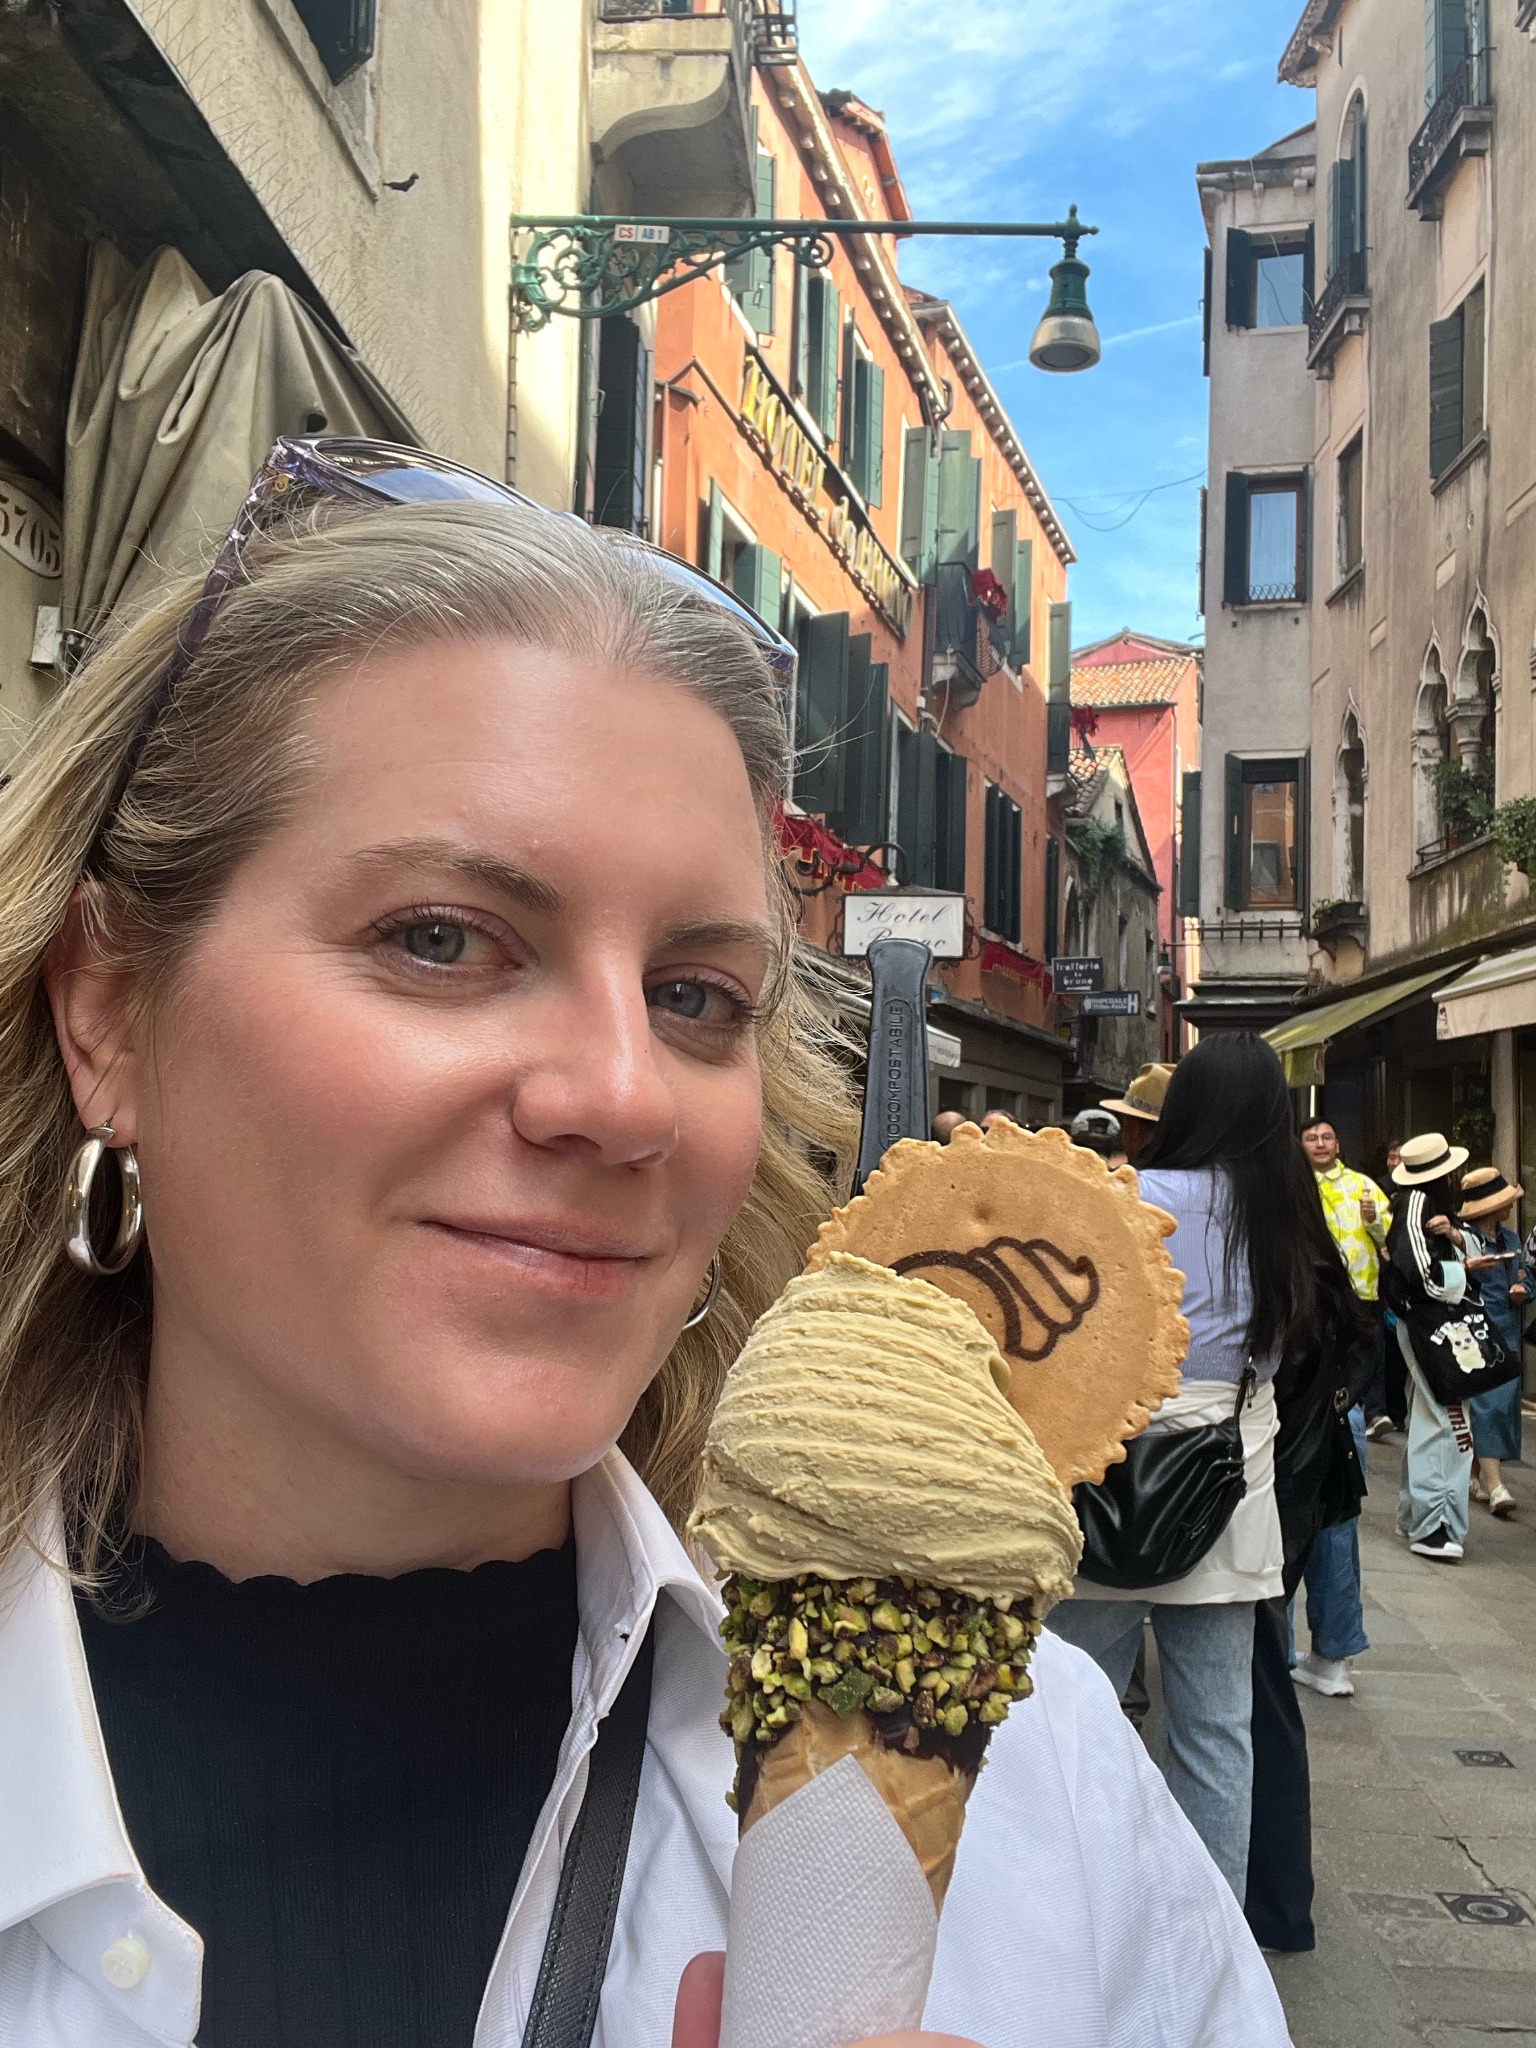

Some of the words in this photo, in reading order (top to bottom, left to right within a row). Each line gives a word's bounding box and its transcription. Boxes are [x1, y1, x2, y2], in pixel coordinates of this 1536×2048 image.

[619, 227, 634, 239] CS
[641, 228, 655, 240] AB
[740, 354, 828, 521] HOTEL
[857, 901, 952, 924] Hotel
